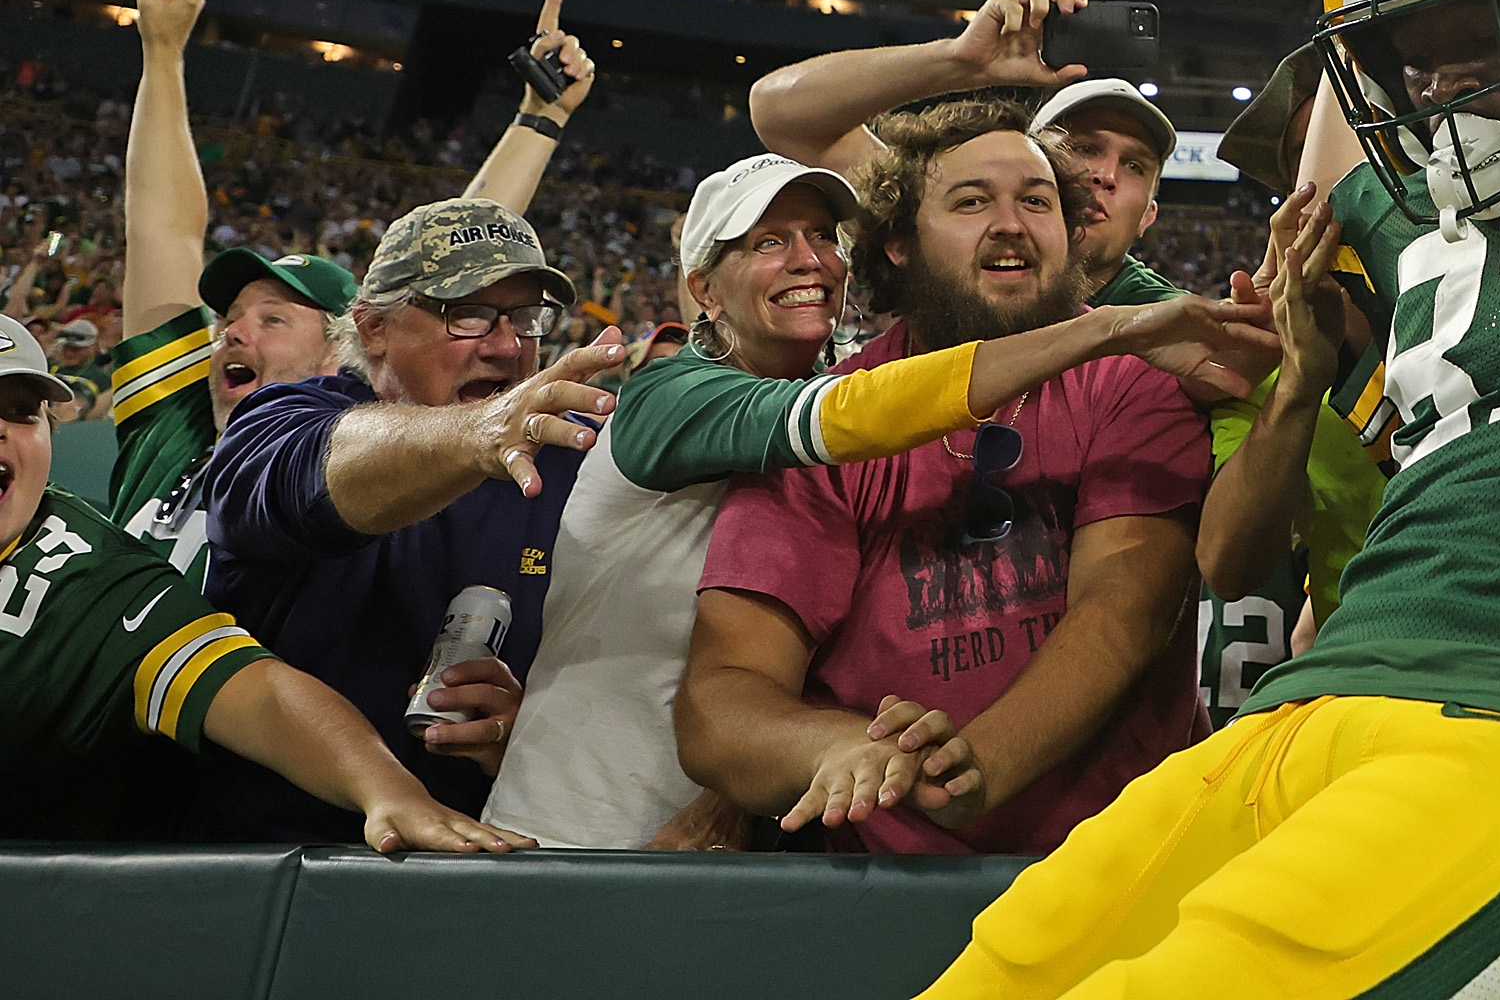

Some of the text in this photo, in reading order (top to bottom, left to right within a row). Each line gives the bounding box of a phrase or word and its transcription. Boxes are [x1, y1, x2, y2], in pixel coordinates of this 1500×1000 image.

[449, 223, 538, 249] AIR FORCE
[929, 626, 1006, 682] HERD
